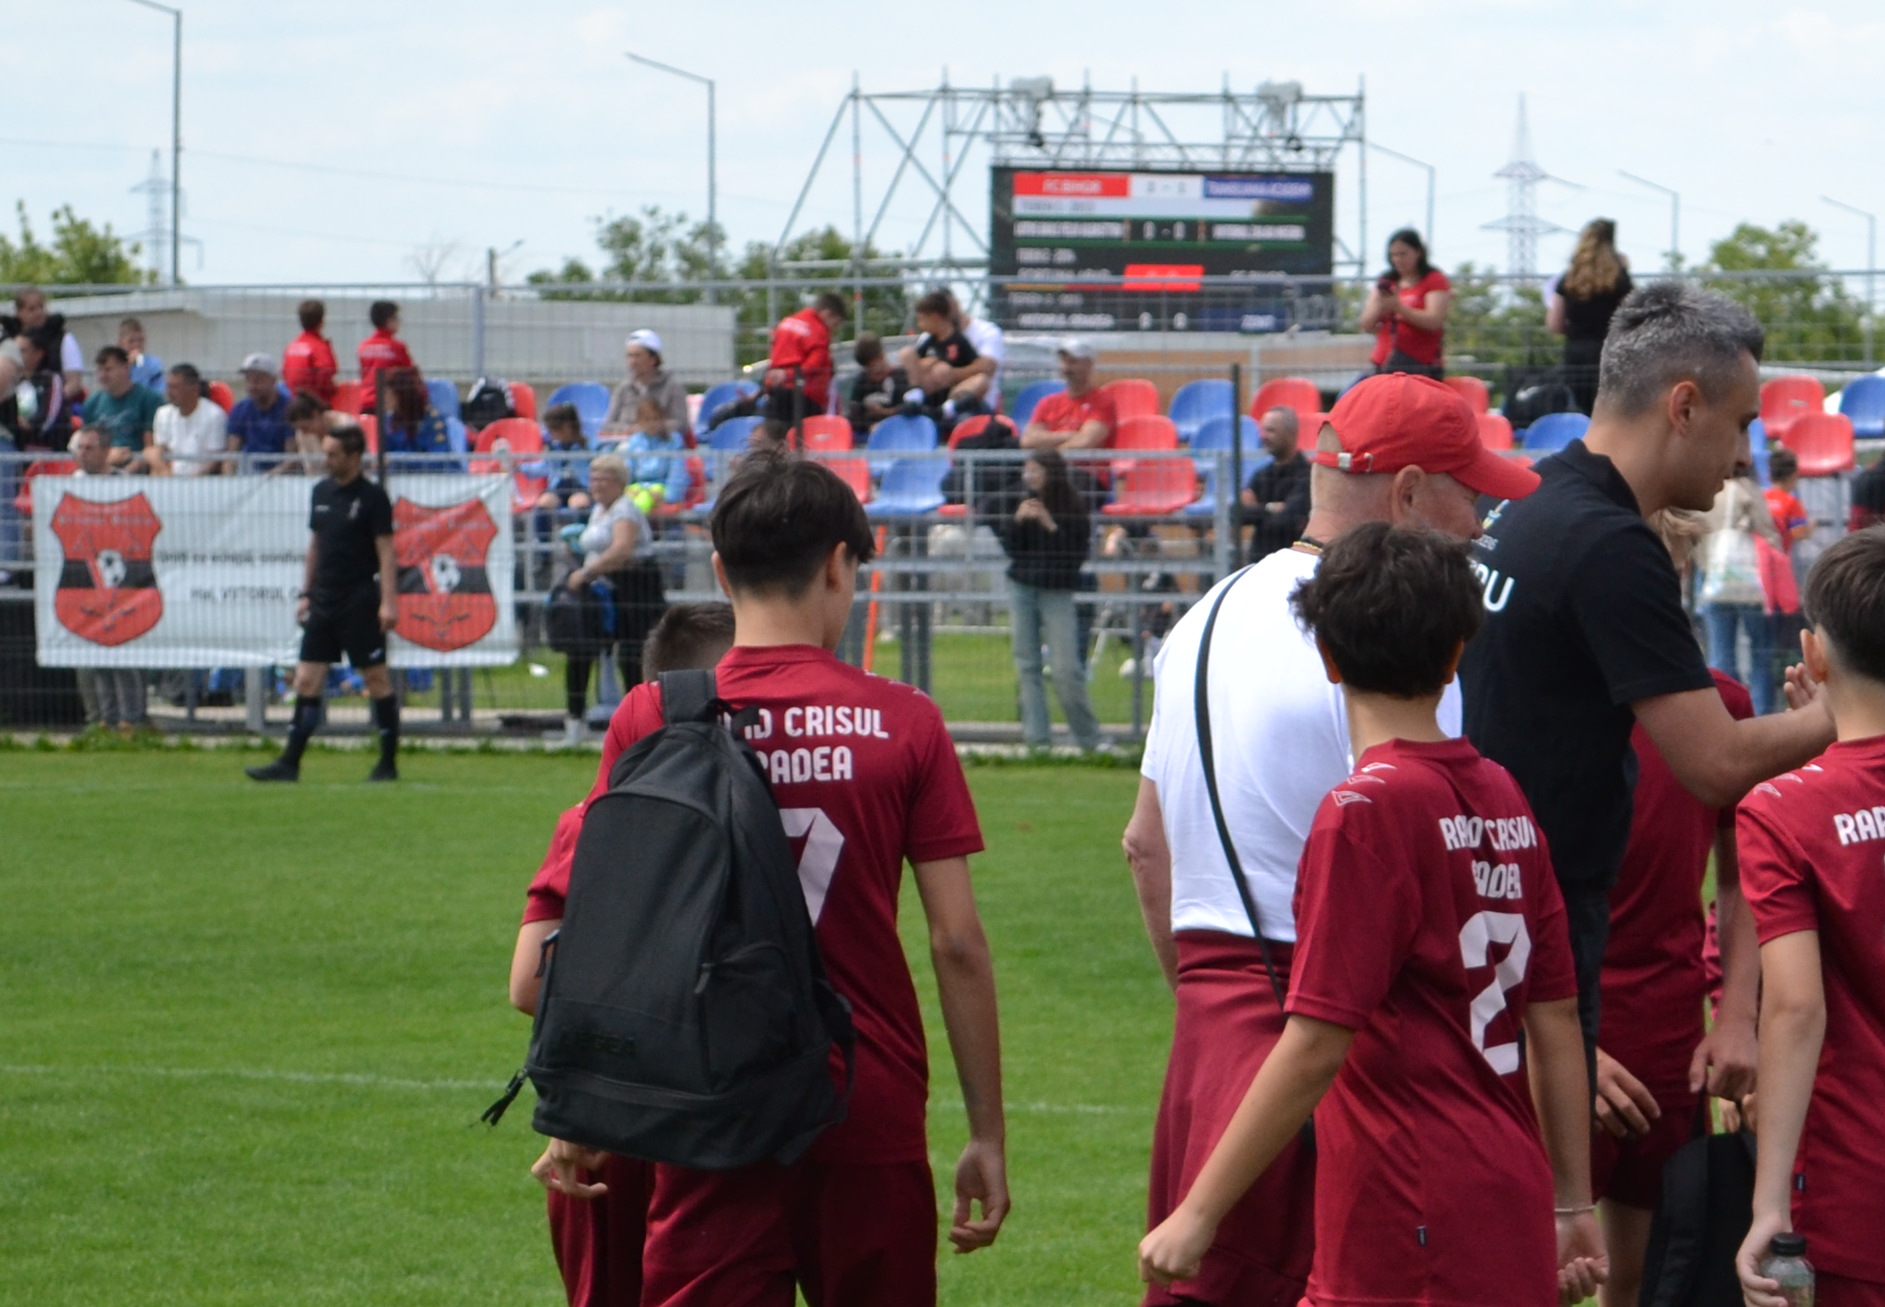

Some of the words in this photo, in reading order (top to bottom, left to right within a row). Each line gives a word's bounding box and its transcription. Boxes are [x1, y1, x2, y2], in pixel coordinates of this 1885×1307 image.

[785, 706, 889, 739] CRISUL
[758, 746, 853, 783] ADEA
[779, 808, 845, 928] 7
[1459, 910, 1532, 1076] 2
